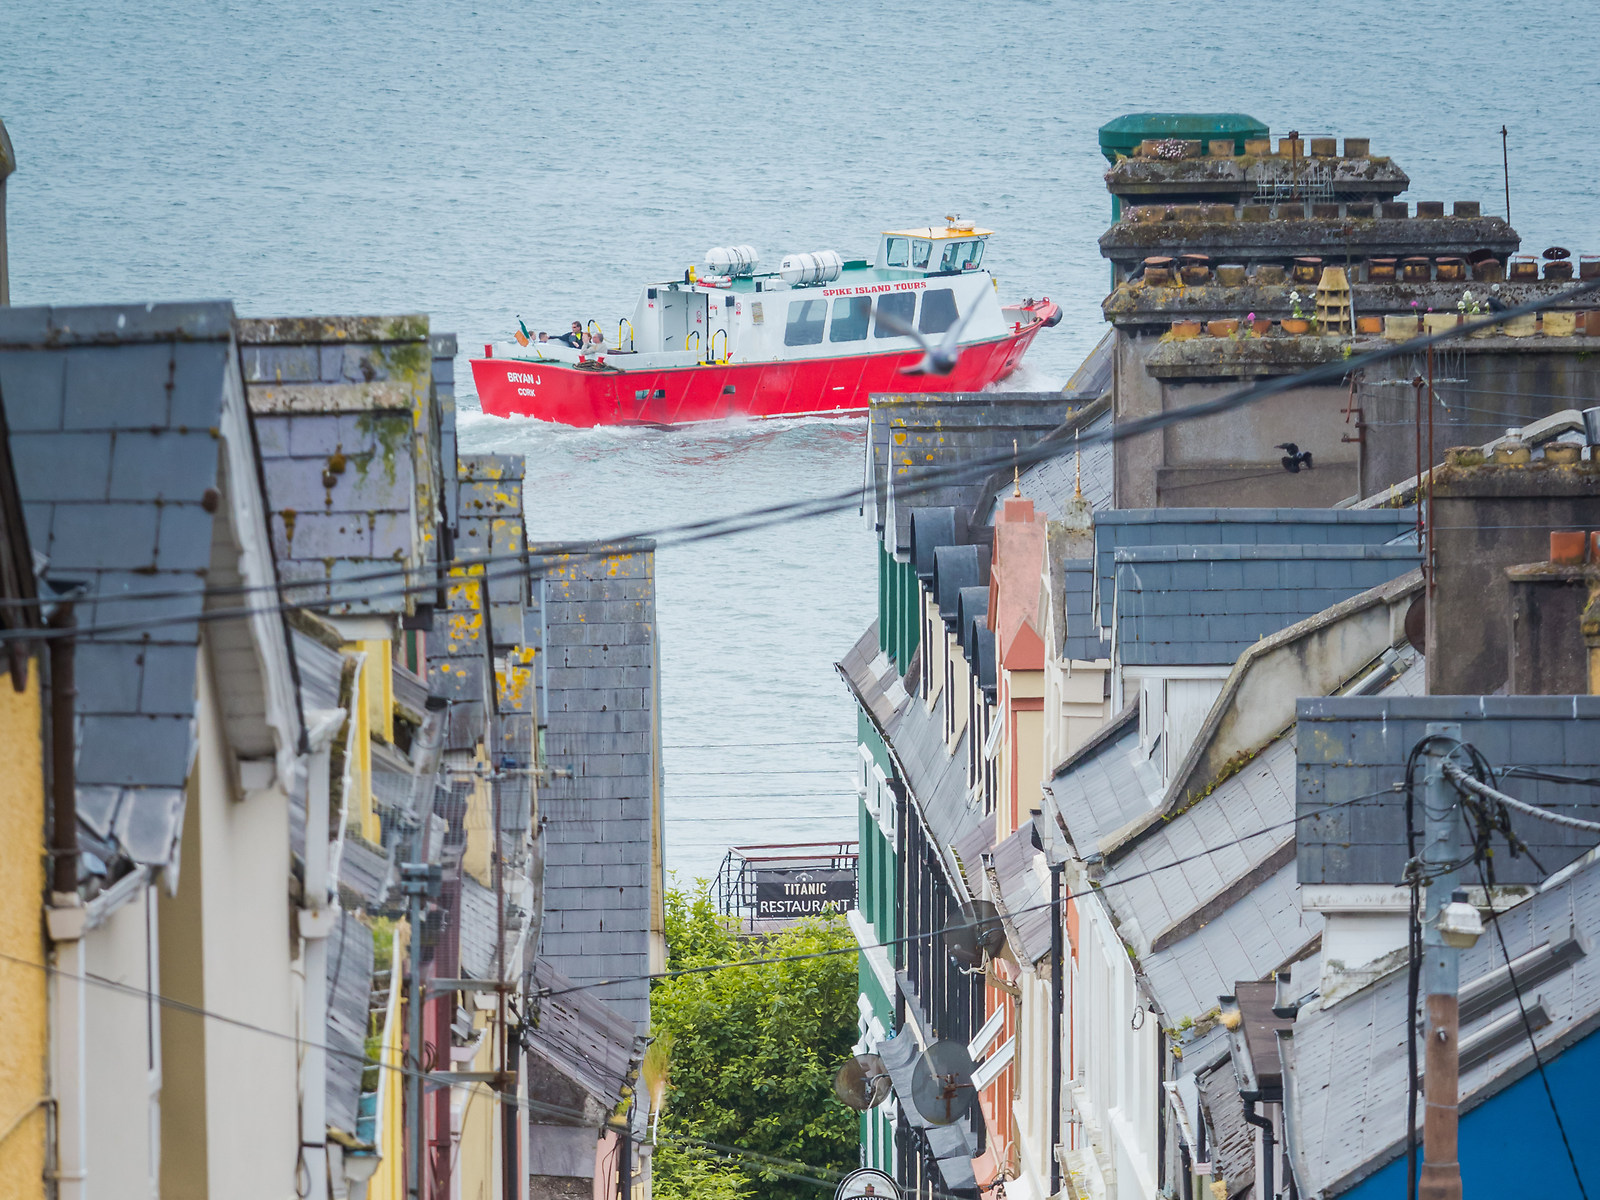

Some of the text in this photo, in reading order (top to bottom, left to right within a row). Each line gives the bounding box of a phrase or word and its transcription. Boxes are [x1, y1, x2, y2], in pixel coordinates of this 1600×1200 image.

[822, 281, 927, 297] SPIKE ISLAND TOURS
[507, 372, 541, 385] BRYAN J
[517, 388, 536, 397] CORK
[784, 883, 827, 895] TITANIC
[760, 900, 850, 913] RESTAURANT
